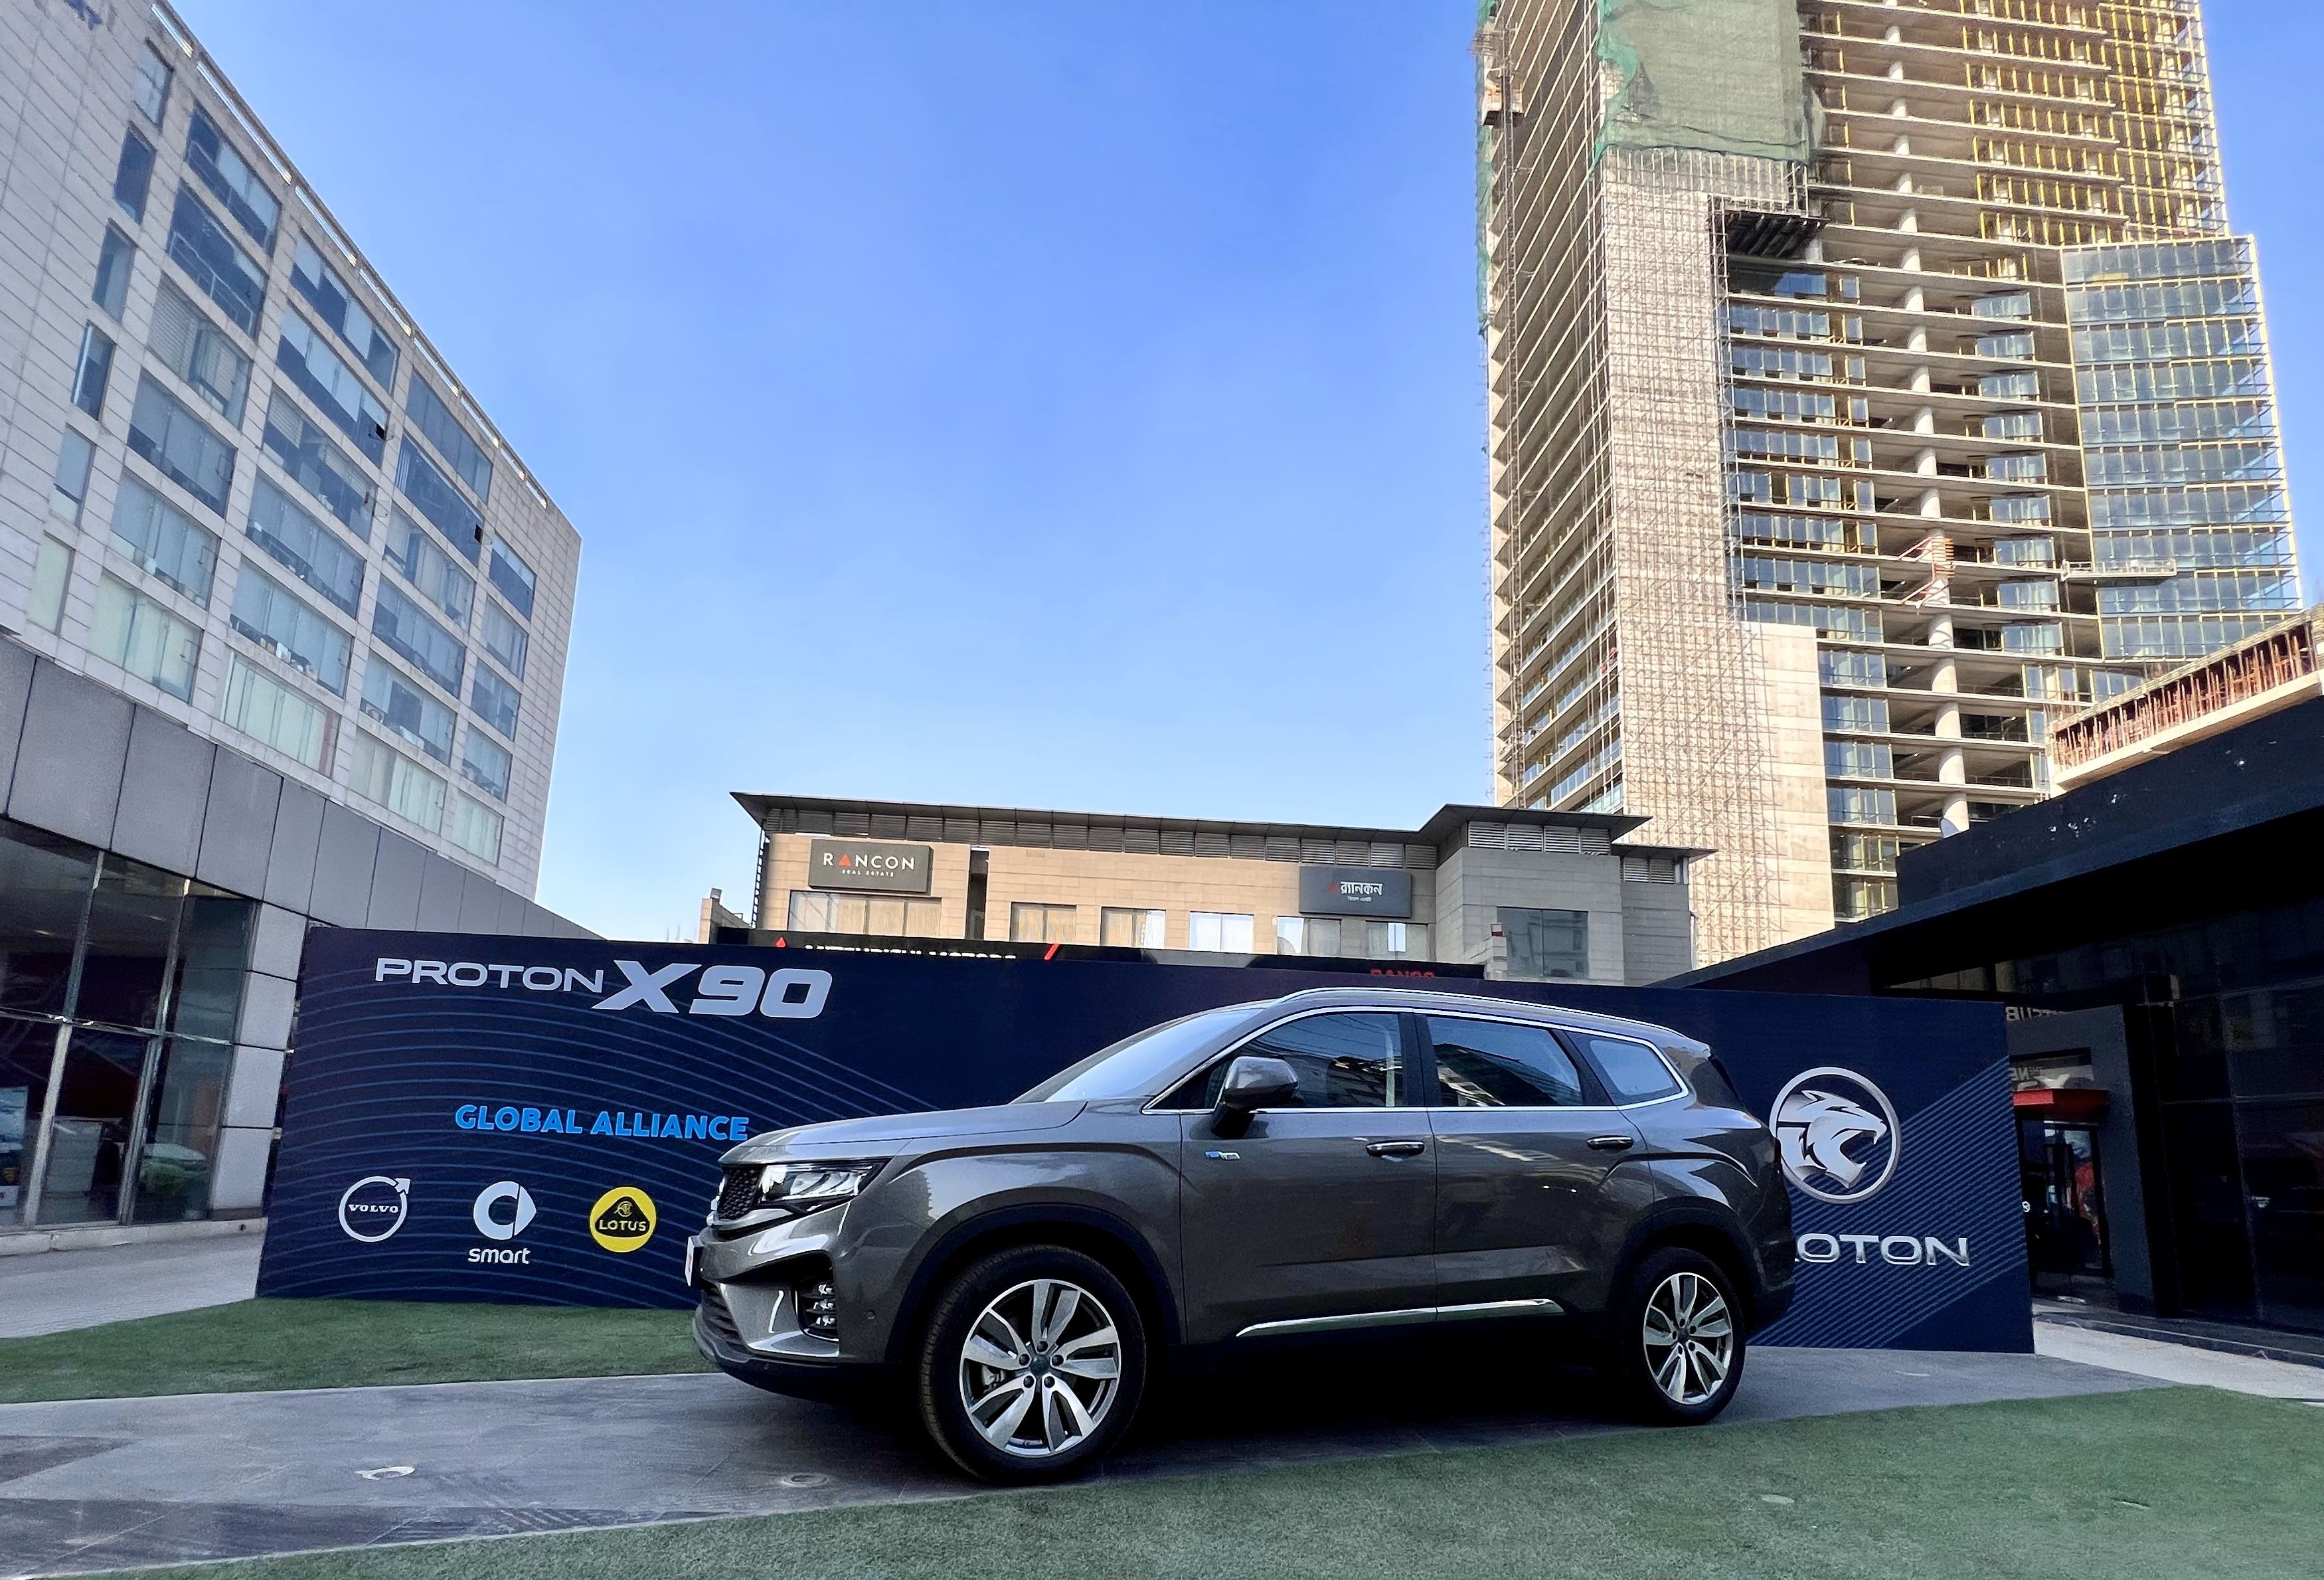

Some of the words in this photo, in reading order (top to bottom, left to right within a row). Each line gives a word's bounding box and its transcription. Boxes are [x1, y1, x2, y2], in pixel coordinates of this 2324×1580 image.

[823, 853, 915, 870] RANCON
[375, 958, 604, 993] PROTON
[591, 960, 833, 1019] X90
[456, 1104, 583, 1134] GLOBAL
[590, 1110, 749, 1140] ALLIANCE
[348, 1204, 399, 1213] VOLVO
[599, 1219, 647, 1231] LOTUS
[467, 1248, 531, 1265] smart
[1794, 1233, 1970, 1267] OTON
